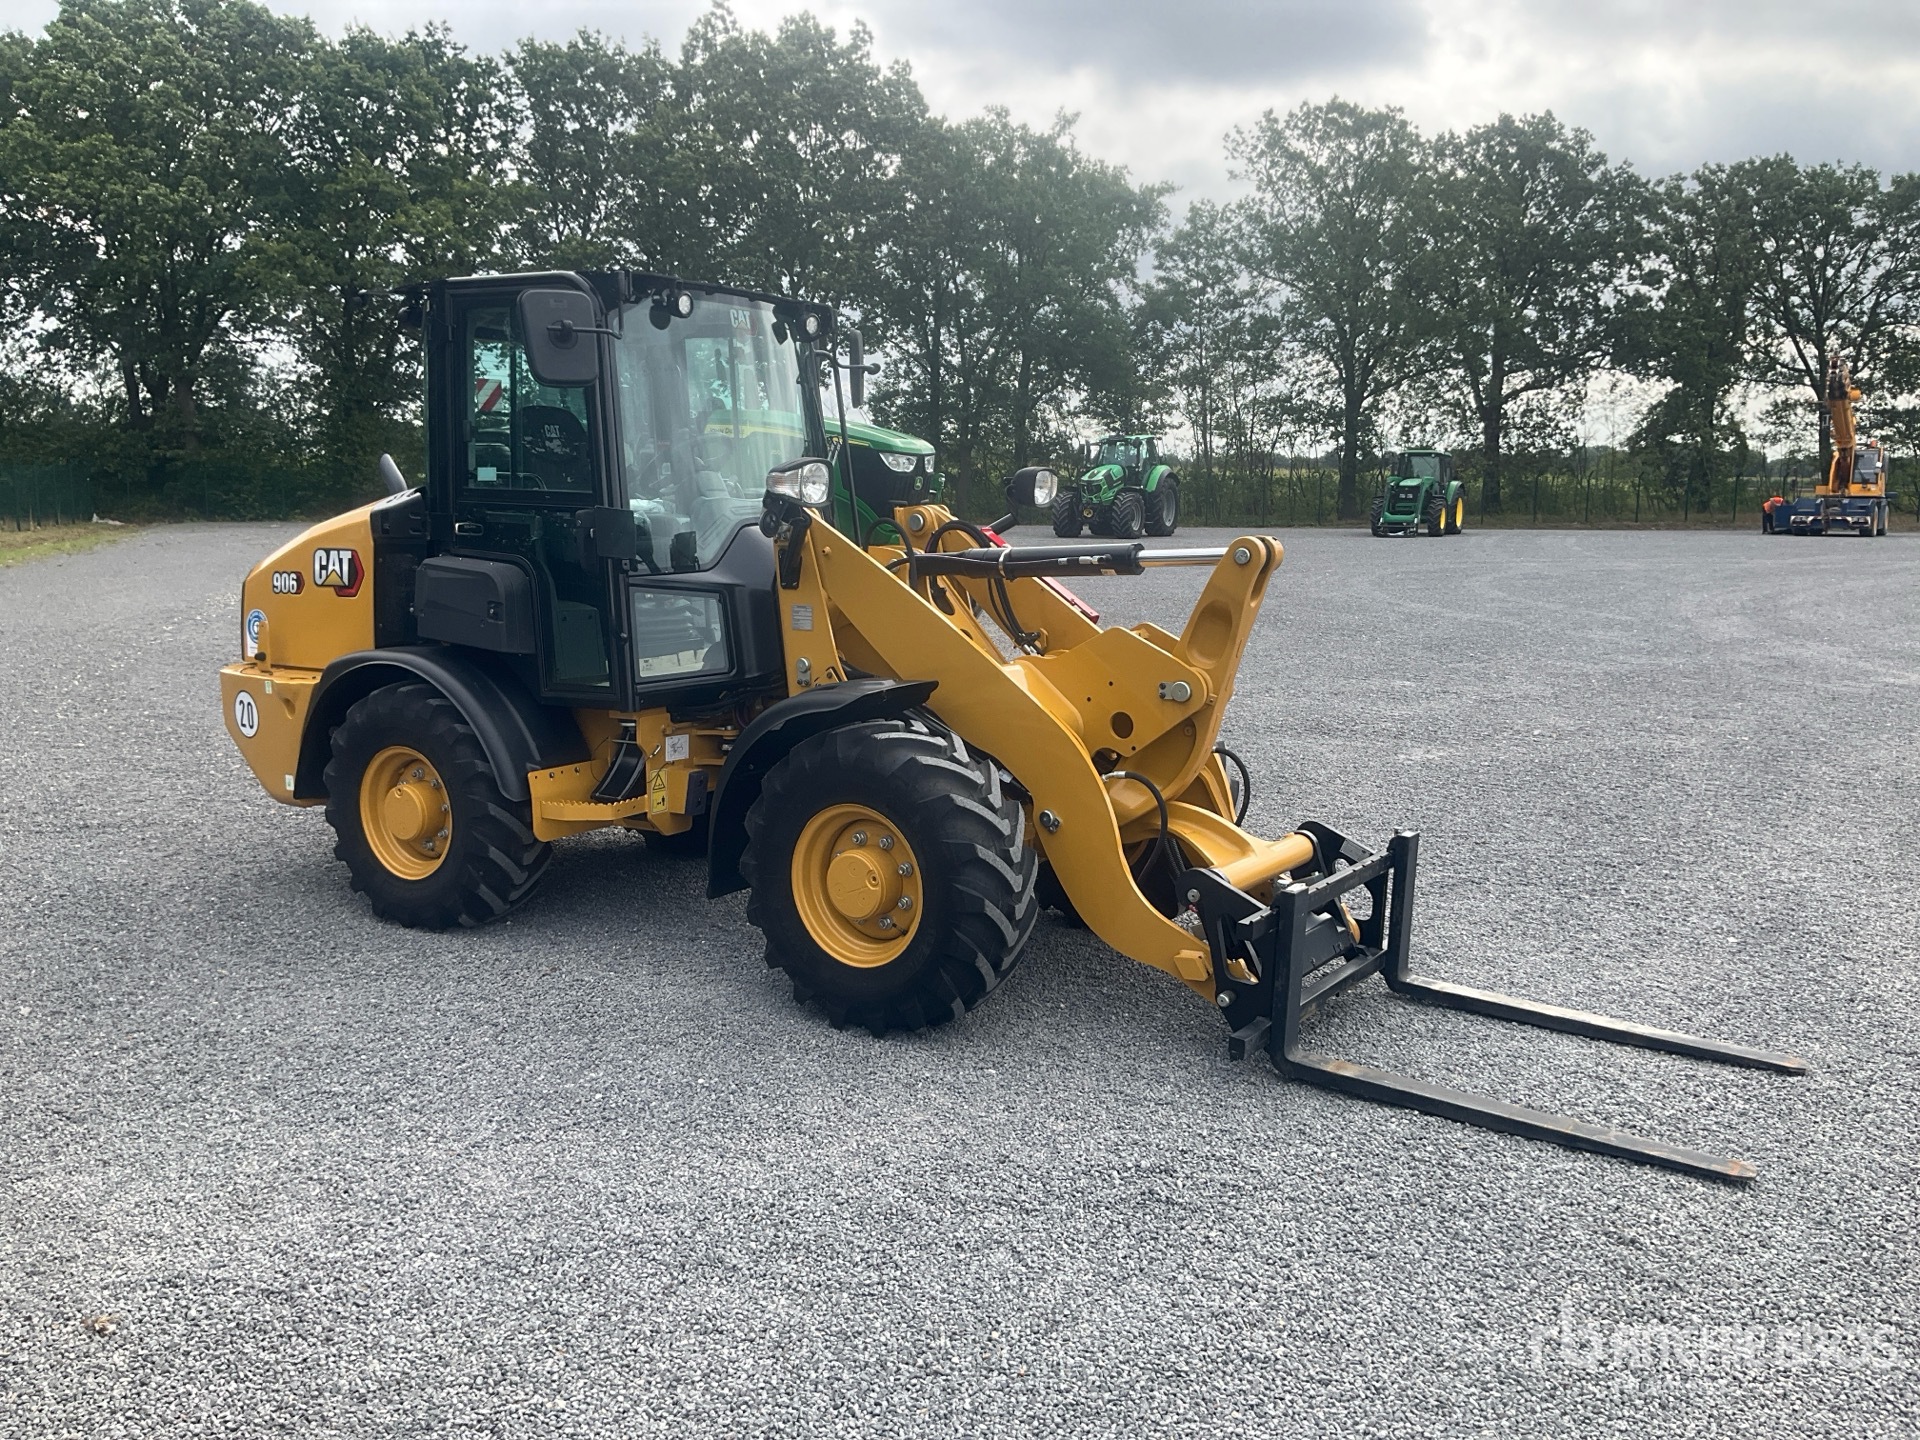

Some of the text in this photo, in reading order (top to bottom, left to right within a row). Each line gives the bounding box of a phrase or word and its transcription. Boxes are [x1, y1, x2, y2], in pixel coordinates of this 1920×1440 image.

[730, 309, 751, 329] CAT
[544, 424, 560, 438] CAT
[314, 549, 352, 586] CAT
[272, 572, 298, 594] 906
[238, 699, 254, 729] 20
